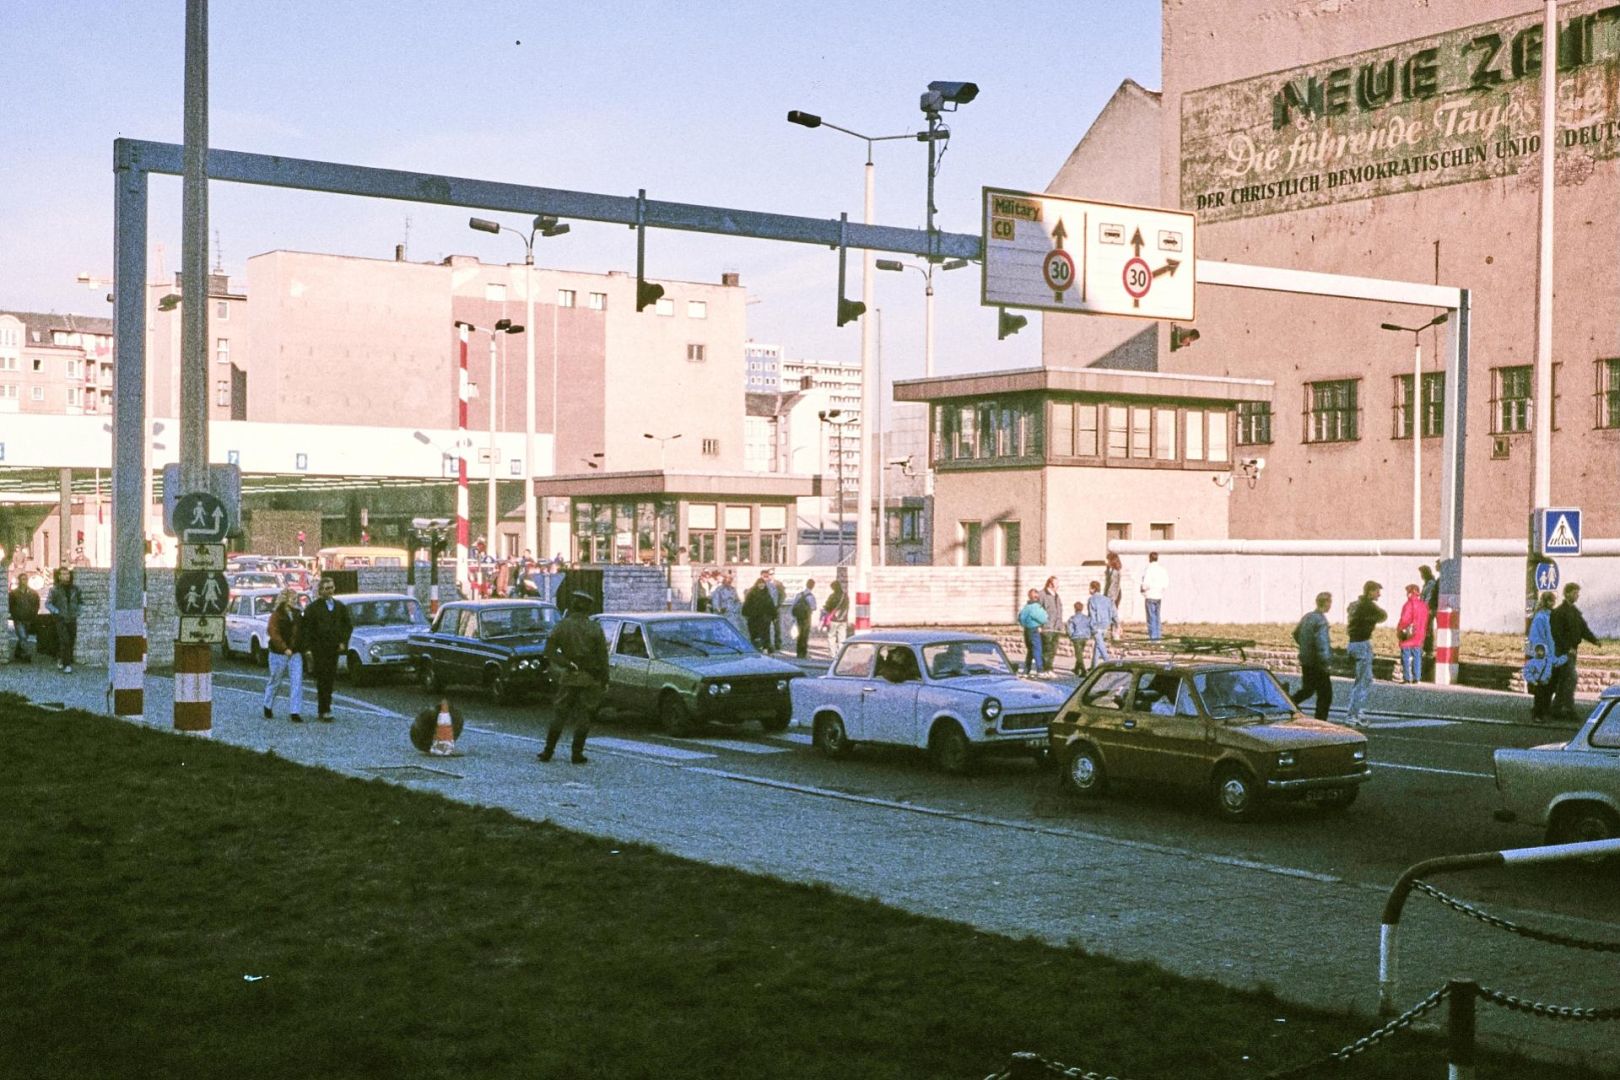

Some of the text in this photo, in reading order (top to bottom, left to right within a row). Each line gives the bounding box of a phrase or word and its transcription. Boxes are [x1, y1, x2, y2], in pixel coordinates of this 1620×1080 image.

[1273, 48, 1438, 130] NEUE
[1222, 133, 1280, 179] Die
[1288, 115, 1423, 172] führende
[1197, 191, 1225, 210] DER
[1230, 174, 1320, 205] CHRISTLICH
[1327, 144, 1488, 189] DEMOKRATISCHEN
[1496, 134, 1541, 159] UNIO
[994, 199, 1041, 221] Military
[994, 221, 1012, 236] CD
[1051, 261, 1070, 281] 30
[1129, 268, 1147, 288] 30
